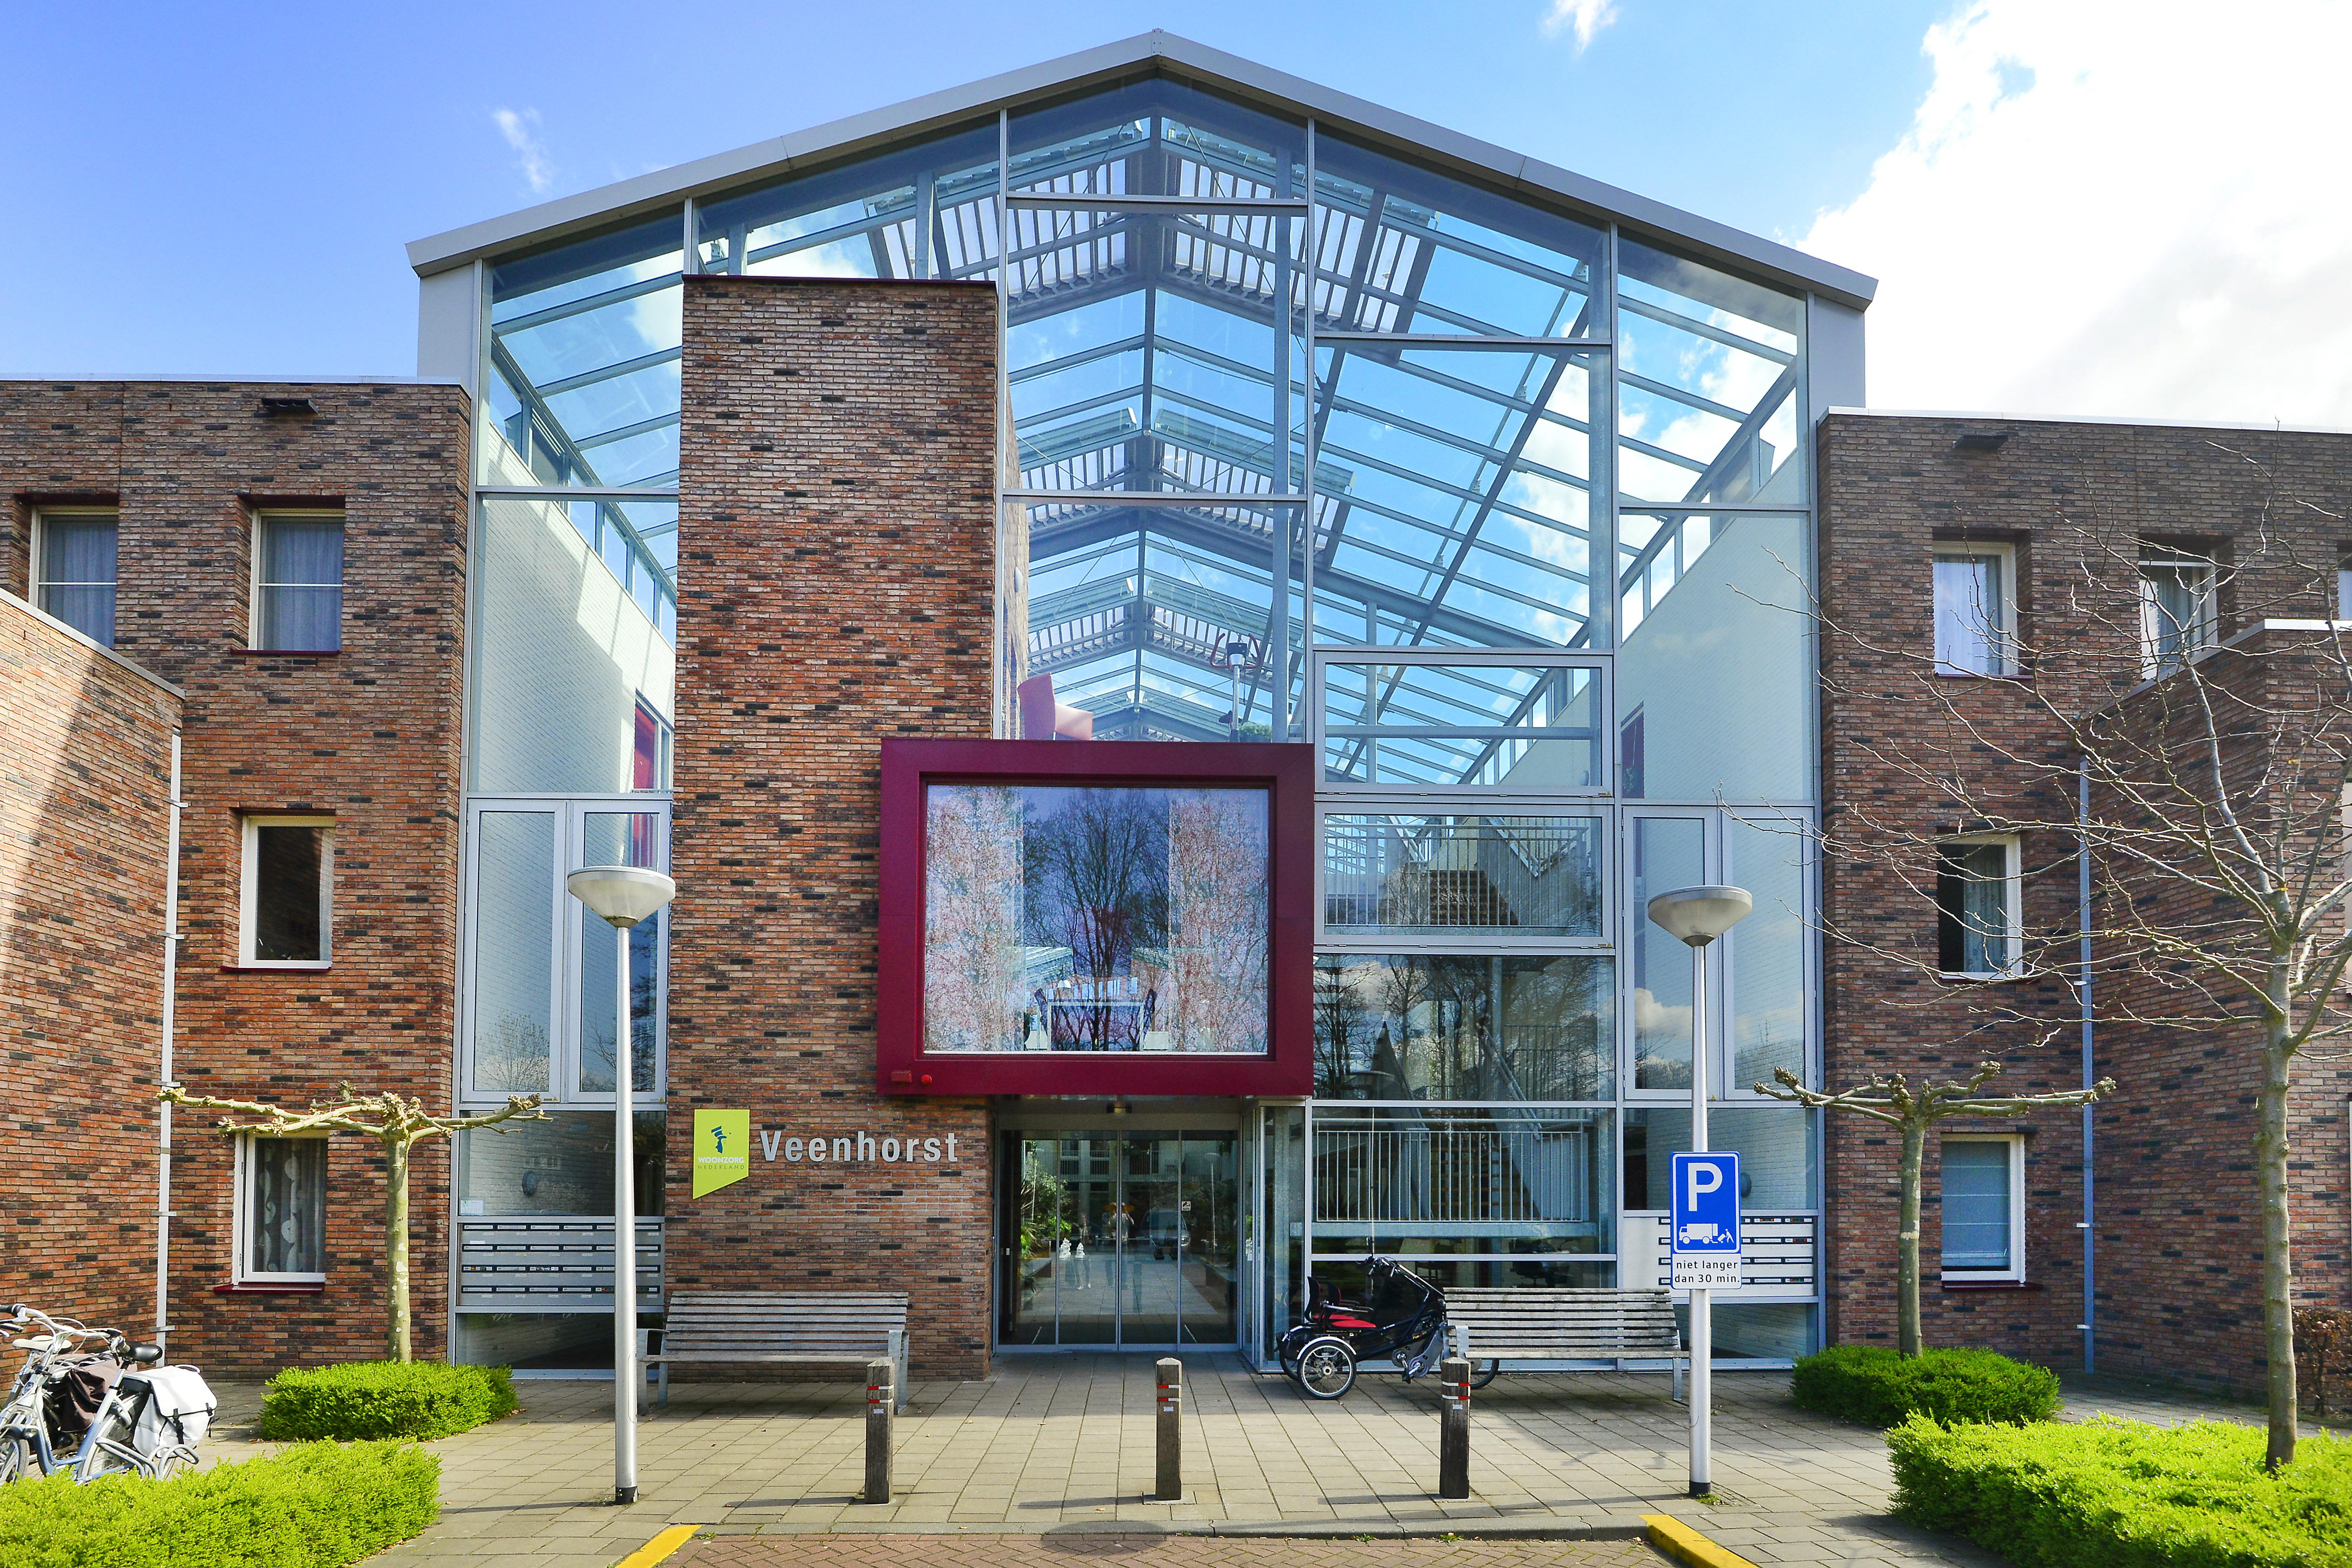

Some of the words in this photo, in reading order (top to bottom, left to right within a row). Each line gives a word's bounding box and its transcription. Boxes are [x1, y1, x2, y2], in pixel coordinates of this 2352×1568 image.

[759, 1131, 958, 1162] Veenhorst
[1688, 1162, 1723, 1211] P
[1676, 1260, 1698, 1269] niet
[1702, 1260, 1738, 1271] langer
[1675, 1274, 1694, 1283] dan
[1698, 1274, 1712, 1283] 30
[1716, 1274, 1740, 1283] min.
